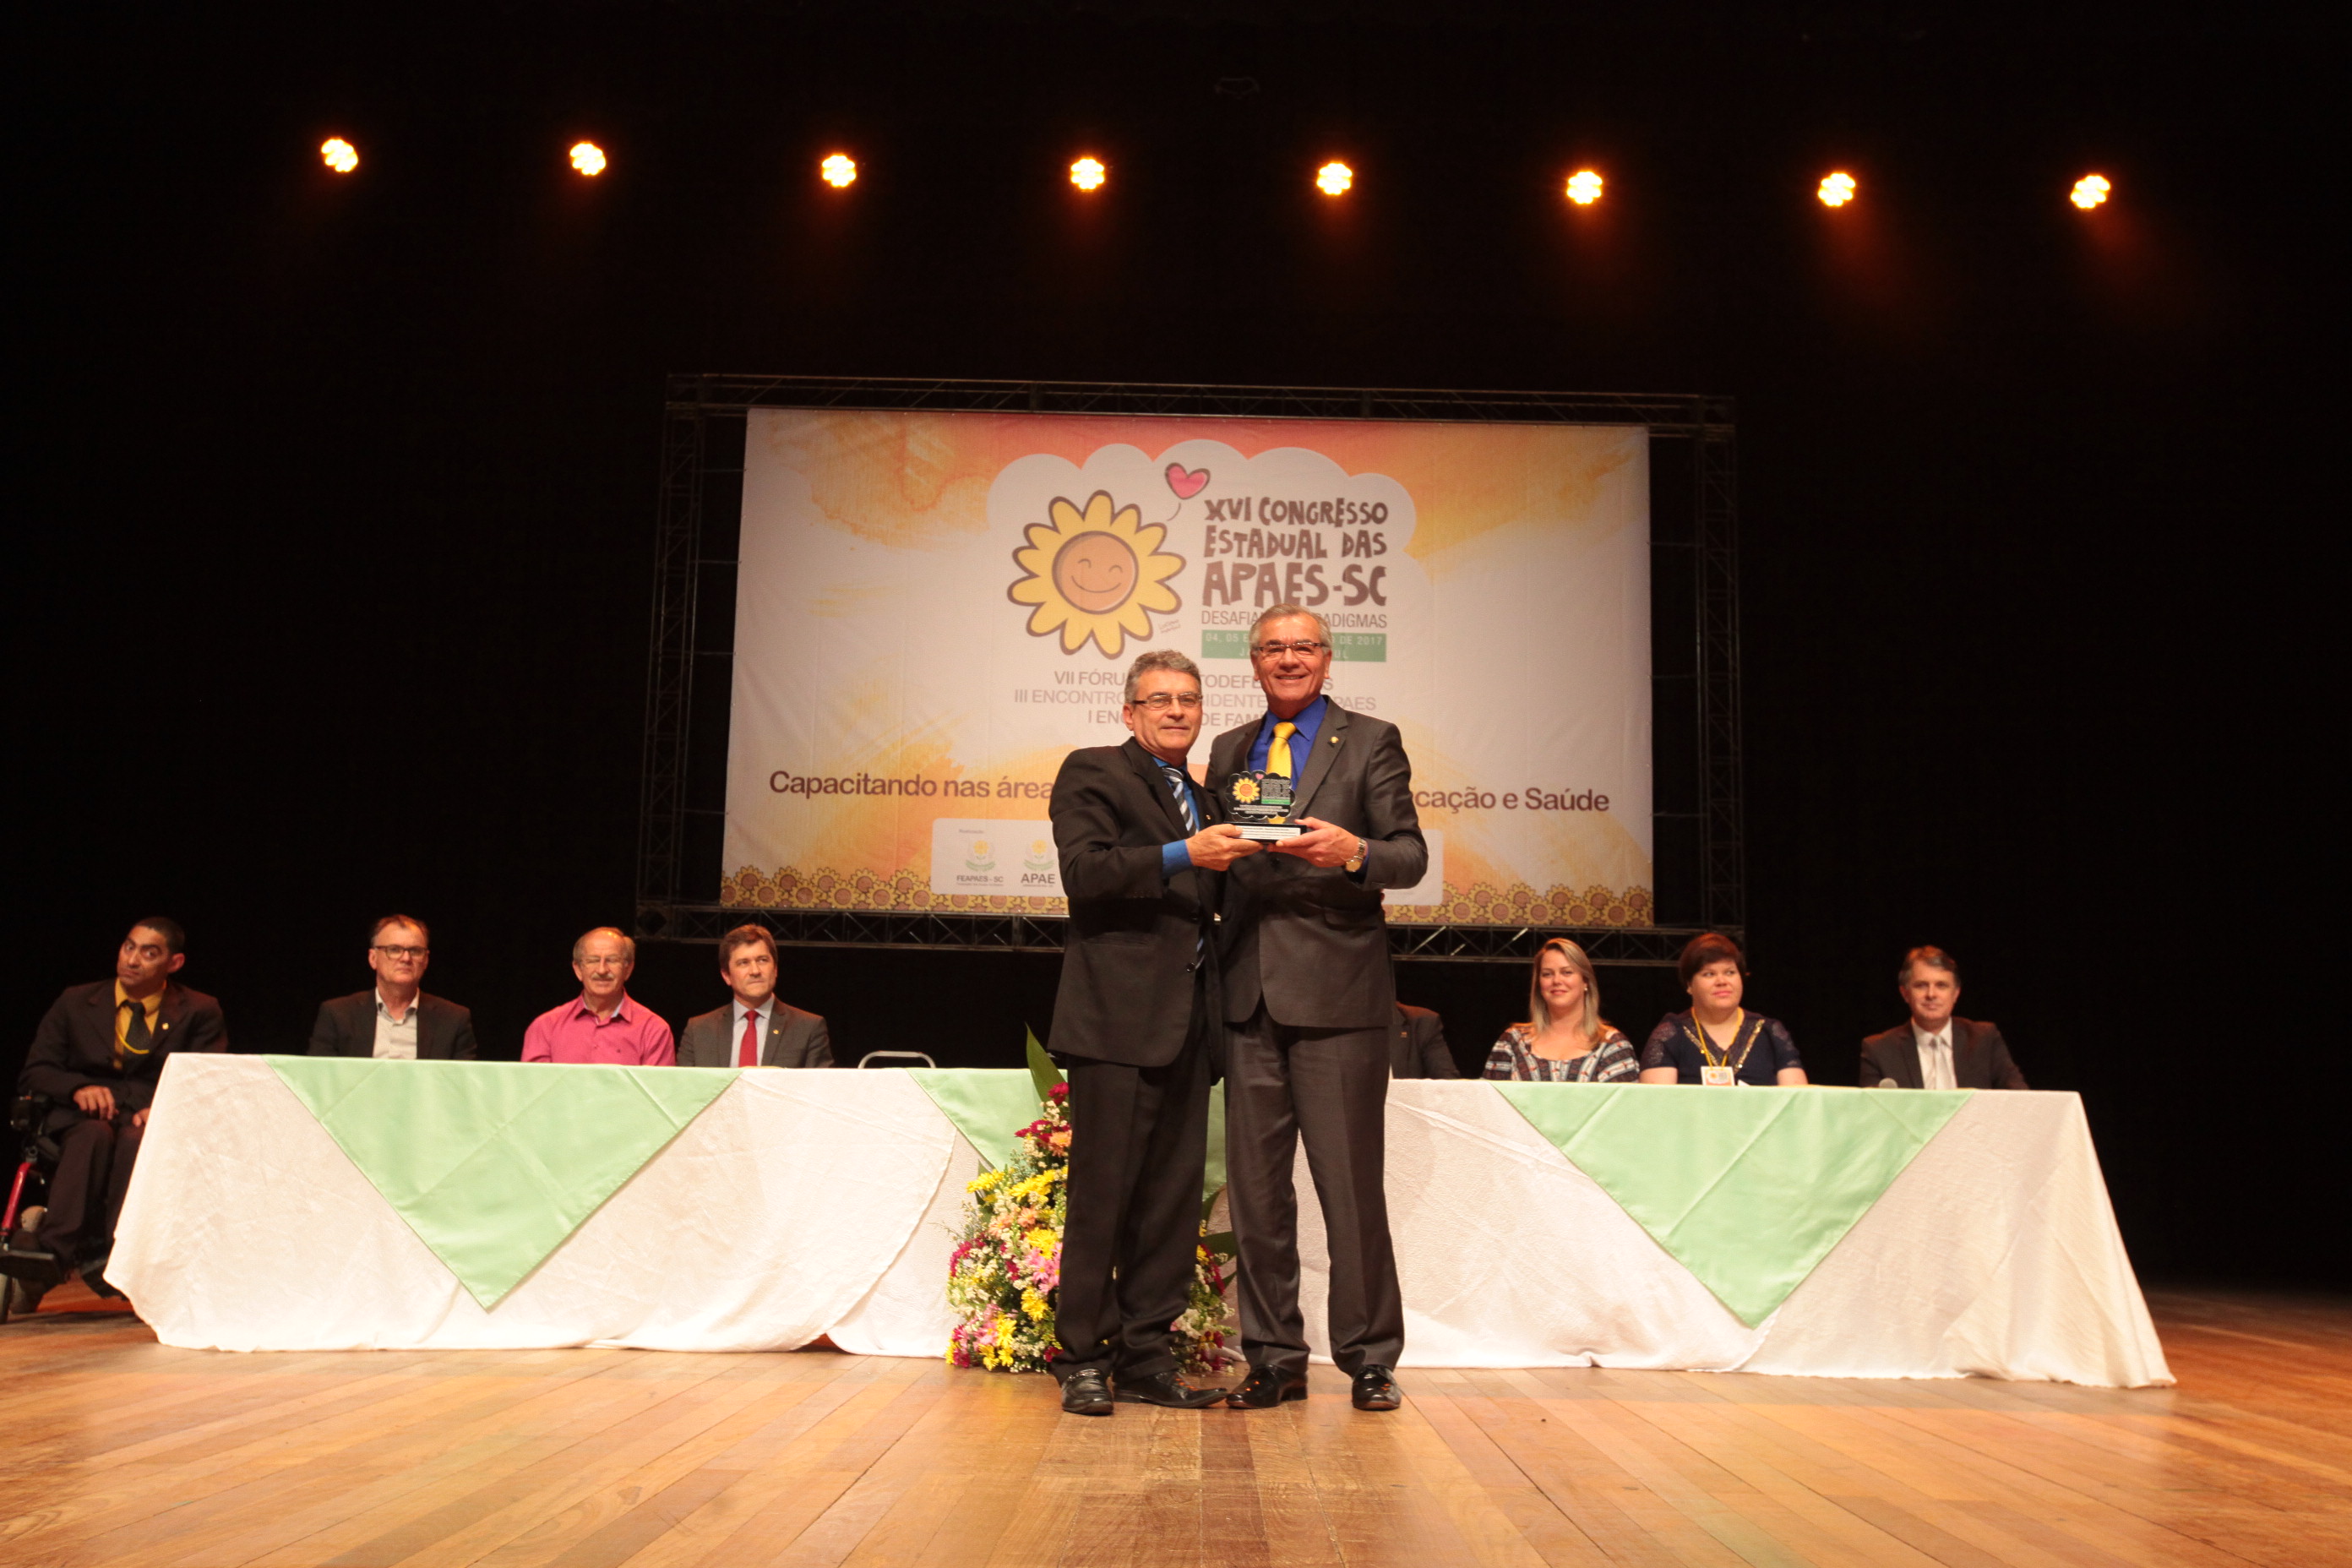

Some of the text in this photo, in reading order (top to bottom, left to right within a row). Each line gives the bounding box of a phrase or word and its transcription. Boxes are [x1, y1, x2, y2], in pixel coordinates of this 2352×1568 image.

[1204, 497, 1388, 527] XVI CONGRESSO
[1204, 525, 1387, 559] ESTADUAL DAS
[1202, 561, 1387, 608] APAES-SC
[1201, 610, 1387, 629] DESAFIA ADIGMAS
[1357, 635, 1383, 645] 2017
[1054, 671, 1075, 685] VII
[1014, 689, 1028, 703] III
[1201, 694, 1267, 709] IDENTE
[769, 770, 937, 799] Capacitando
[943, 778, 991, 798] nas
[1502, 791, 1519, 809] e
[1524, 787, 1609, 812] Saúde
[1021, 873, 1055, 885] APAE
